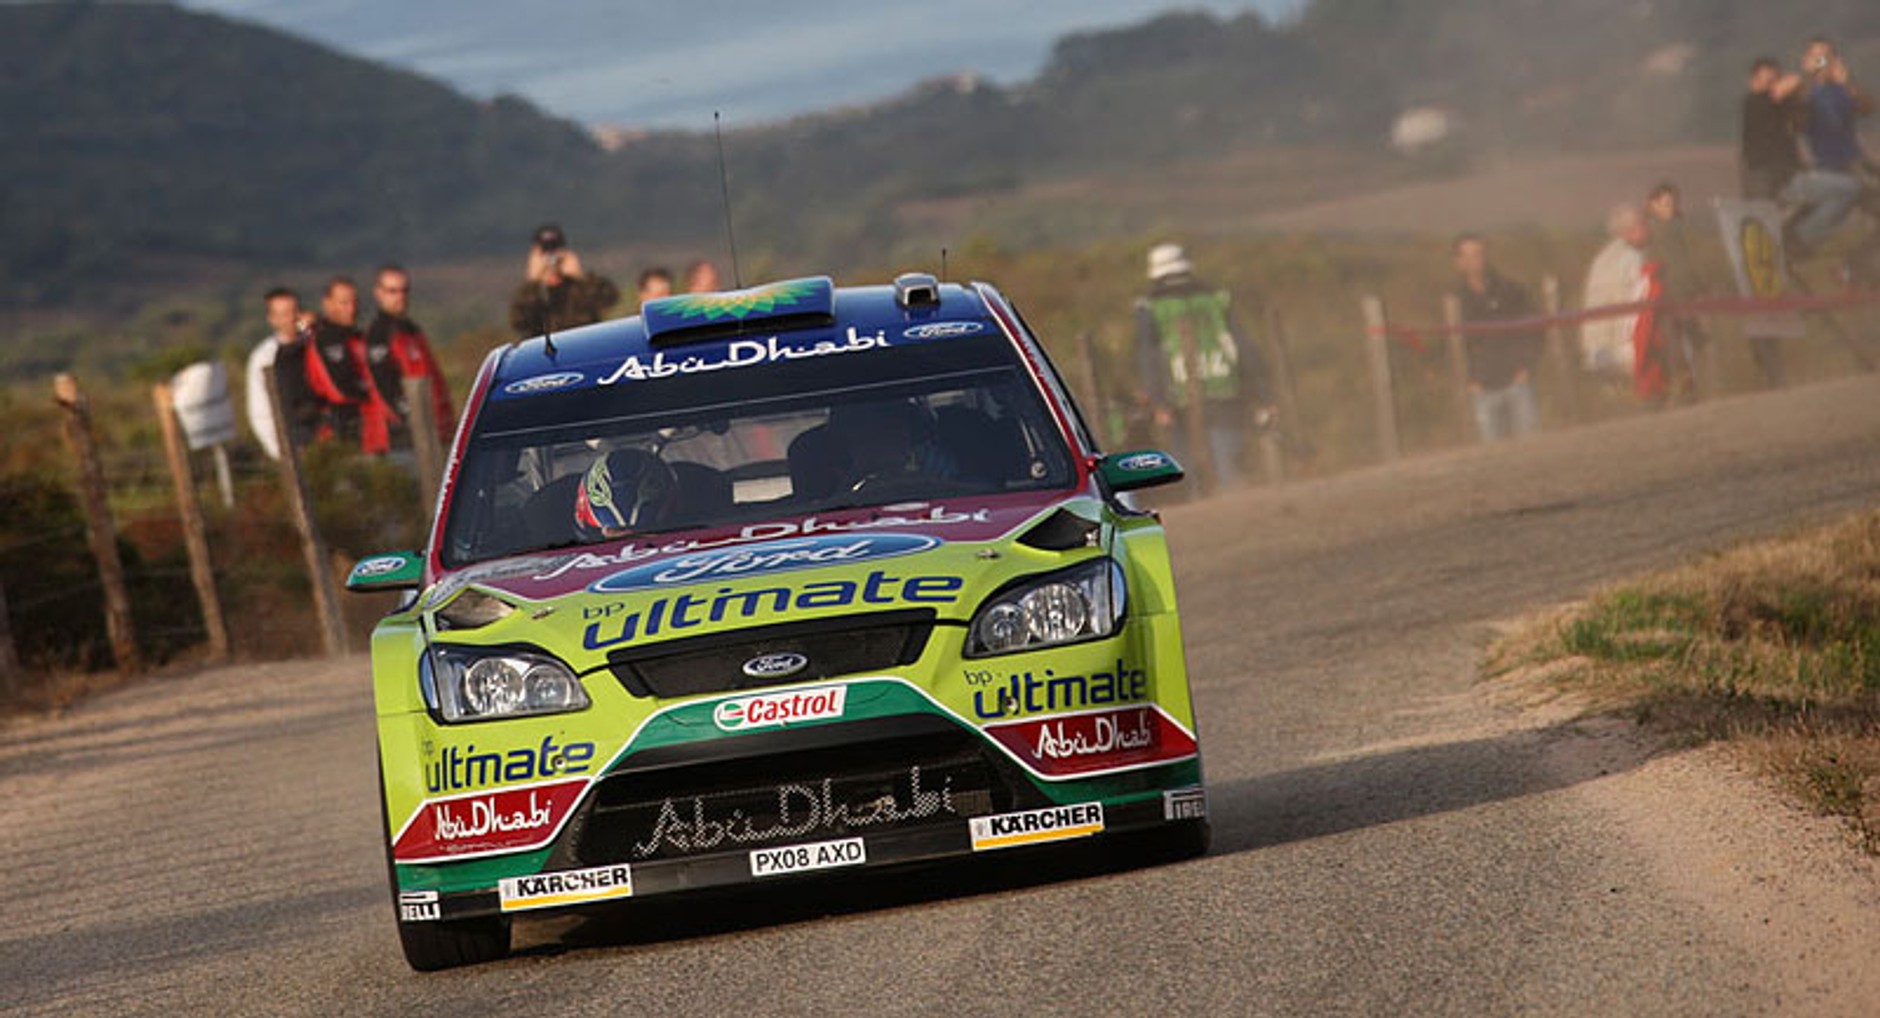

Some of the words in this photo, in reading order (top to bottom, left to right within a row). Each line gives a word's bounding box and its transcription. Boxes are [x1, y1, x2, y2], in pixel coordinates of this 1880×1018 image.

[653, 539, 874, 582] Ford
[583, 571, 965, 650] ultimate
[963, 669, 993, 687] bp
[973, 658, 1148, 719] ultimate
[746, 690, 837, 724] Castrol
[425, 735, 595, 793] ultimate
[990, 804, 1102, 836] KÄRCHER
[755, 847, 810, 873] PX08
[816, 841, 862, 865] AXD
[516, 867, 629, 898] KÄRCHER
